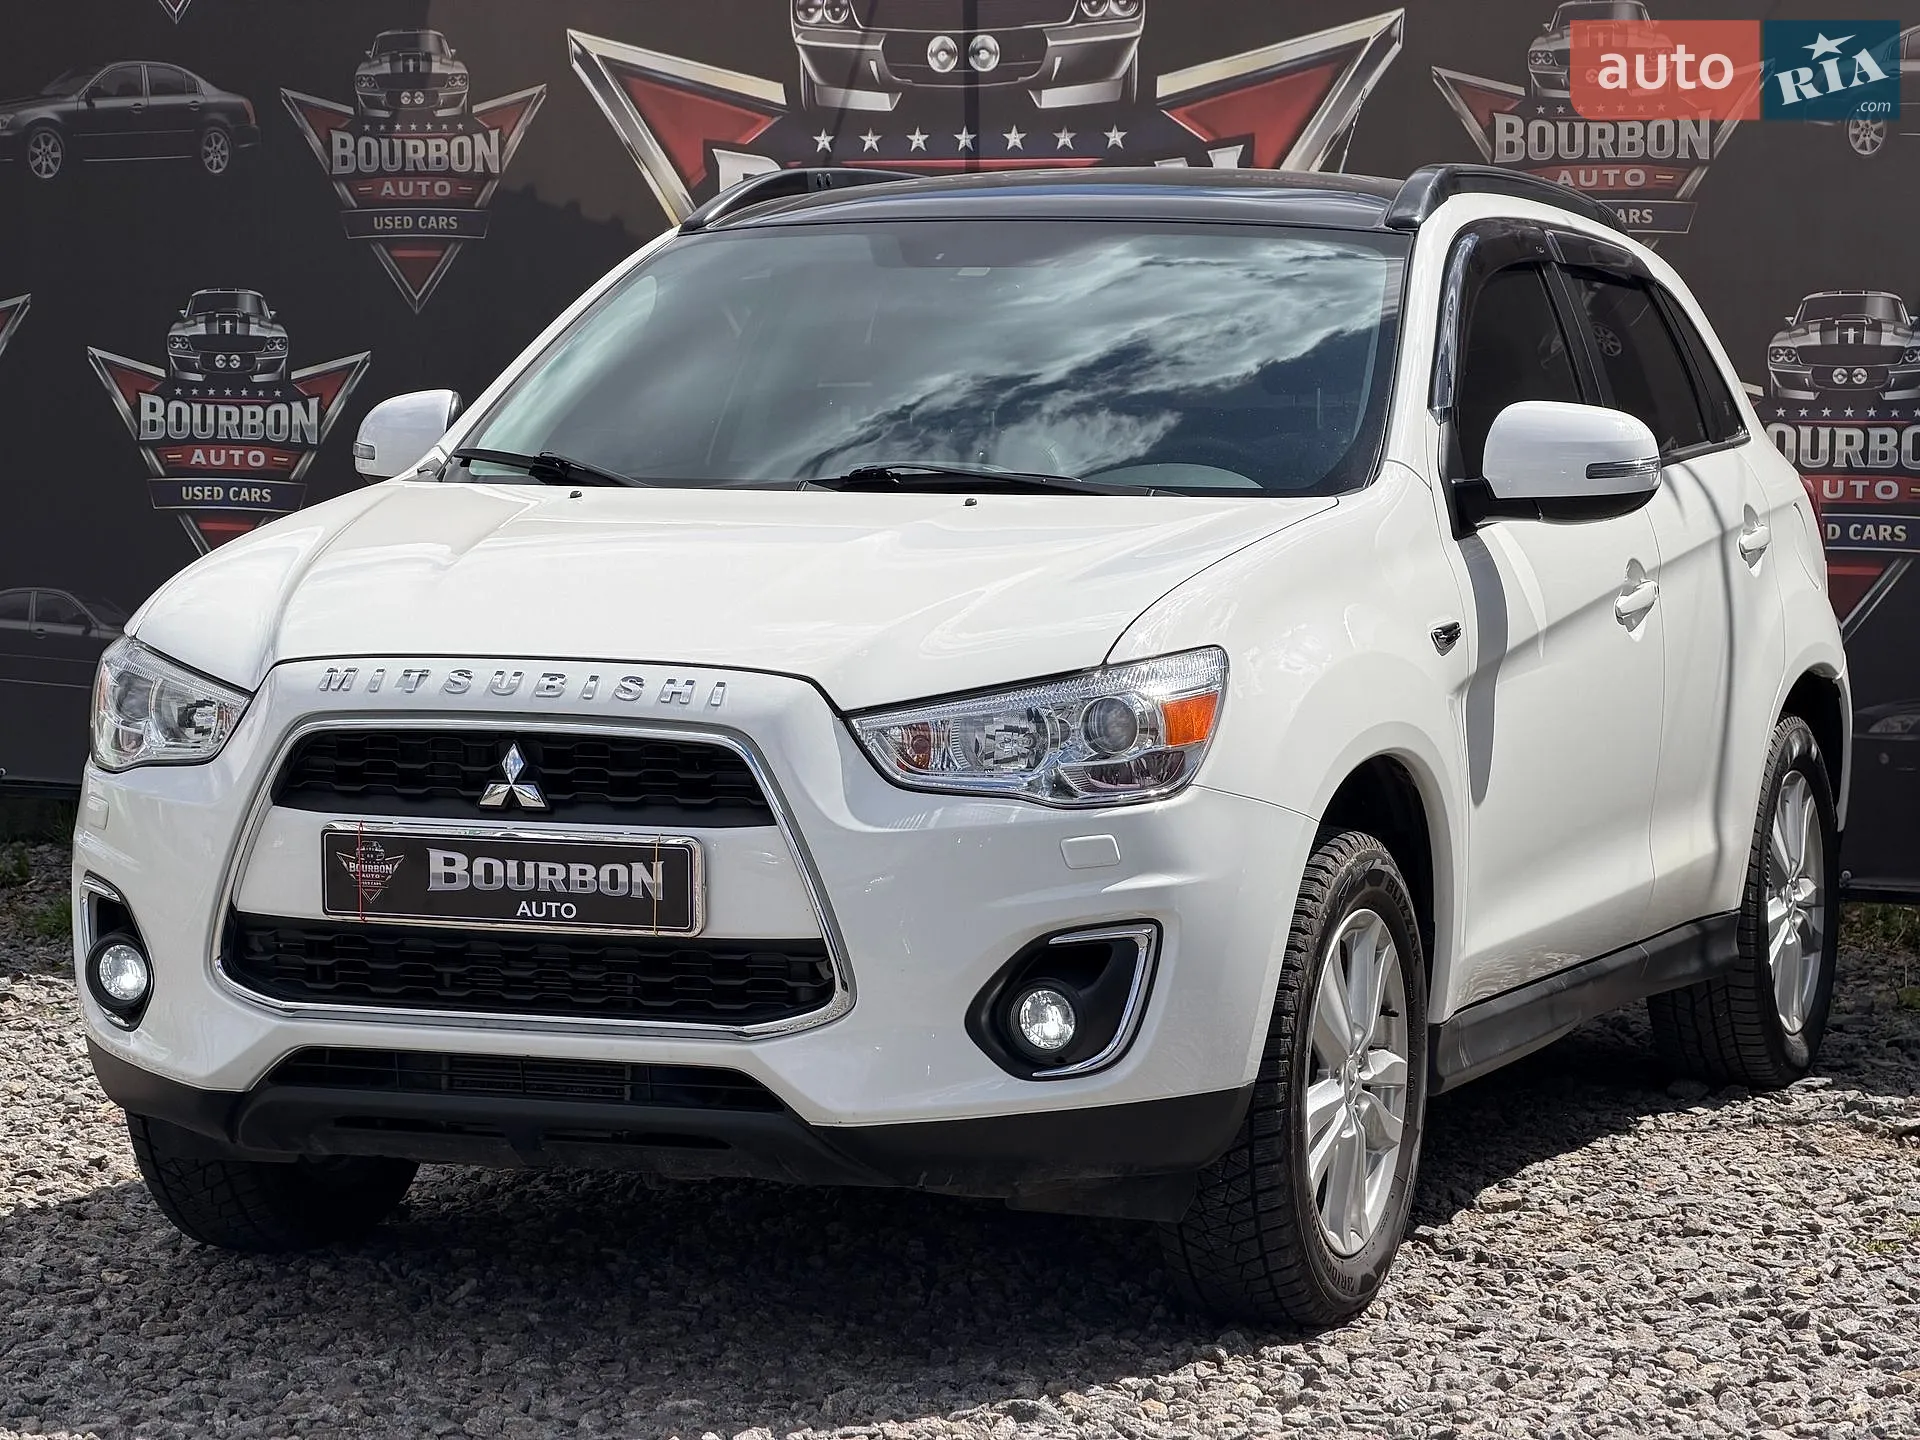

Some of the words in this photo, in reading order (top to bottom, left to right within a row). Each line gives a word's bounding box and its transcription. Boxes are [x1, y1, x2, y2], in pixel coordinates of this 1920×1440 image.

[1493, 109, 1712, 164] BOURBON
[330, 129, 500, 174] BOURBON
[1556, 168, 1646, 187] AUTO
[380, 181, 451, 196] AUTO
[373, 216, 413, 230] USED
[418, 216, 458, 230] CARS
[1615, 208, 1653, 224] ARS
[139, 392, 320, 445] BOURBON
[1766, 422, 1920, 470] OURBO
[190, 449, 266, 467] AUTO
[182, 486, 224, 501] USED
[229, 487, 272, 503] CARS
[1822, 479, 1899, 500] UTO
[1848, 523, 1907, 542] CARS
[318, 666, 728, 706] MITSUBISHI
[426, 848, 665, 901] BOURBON
[516, 900, 577, 919] AUTO
